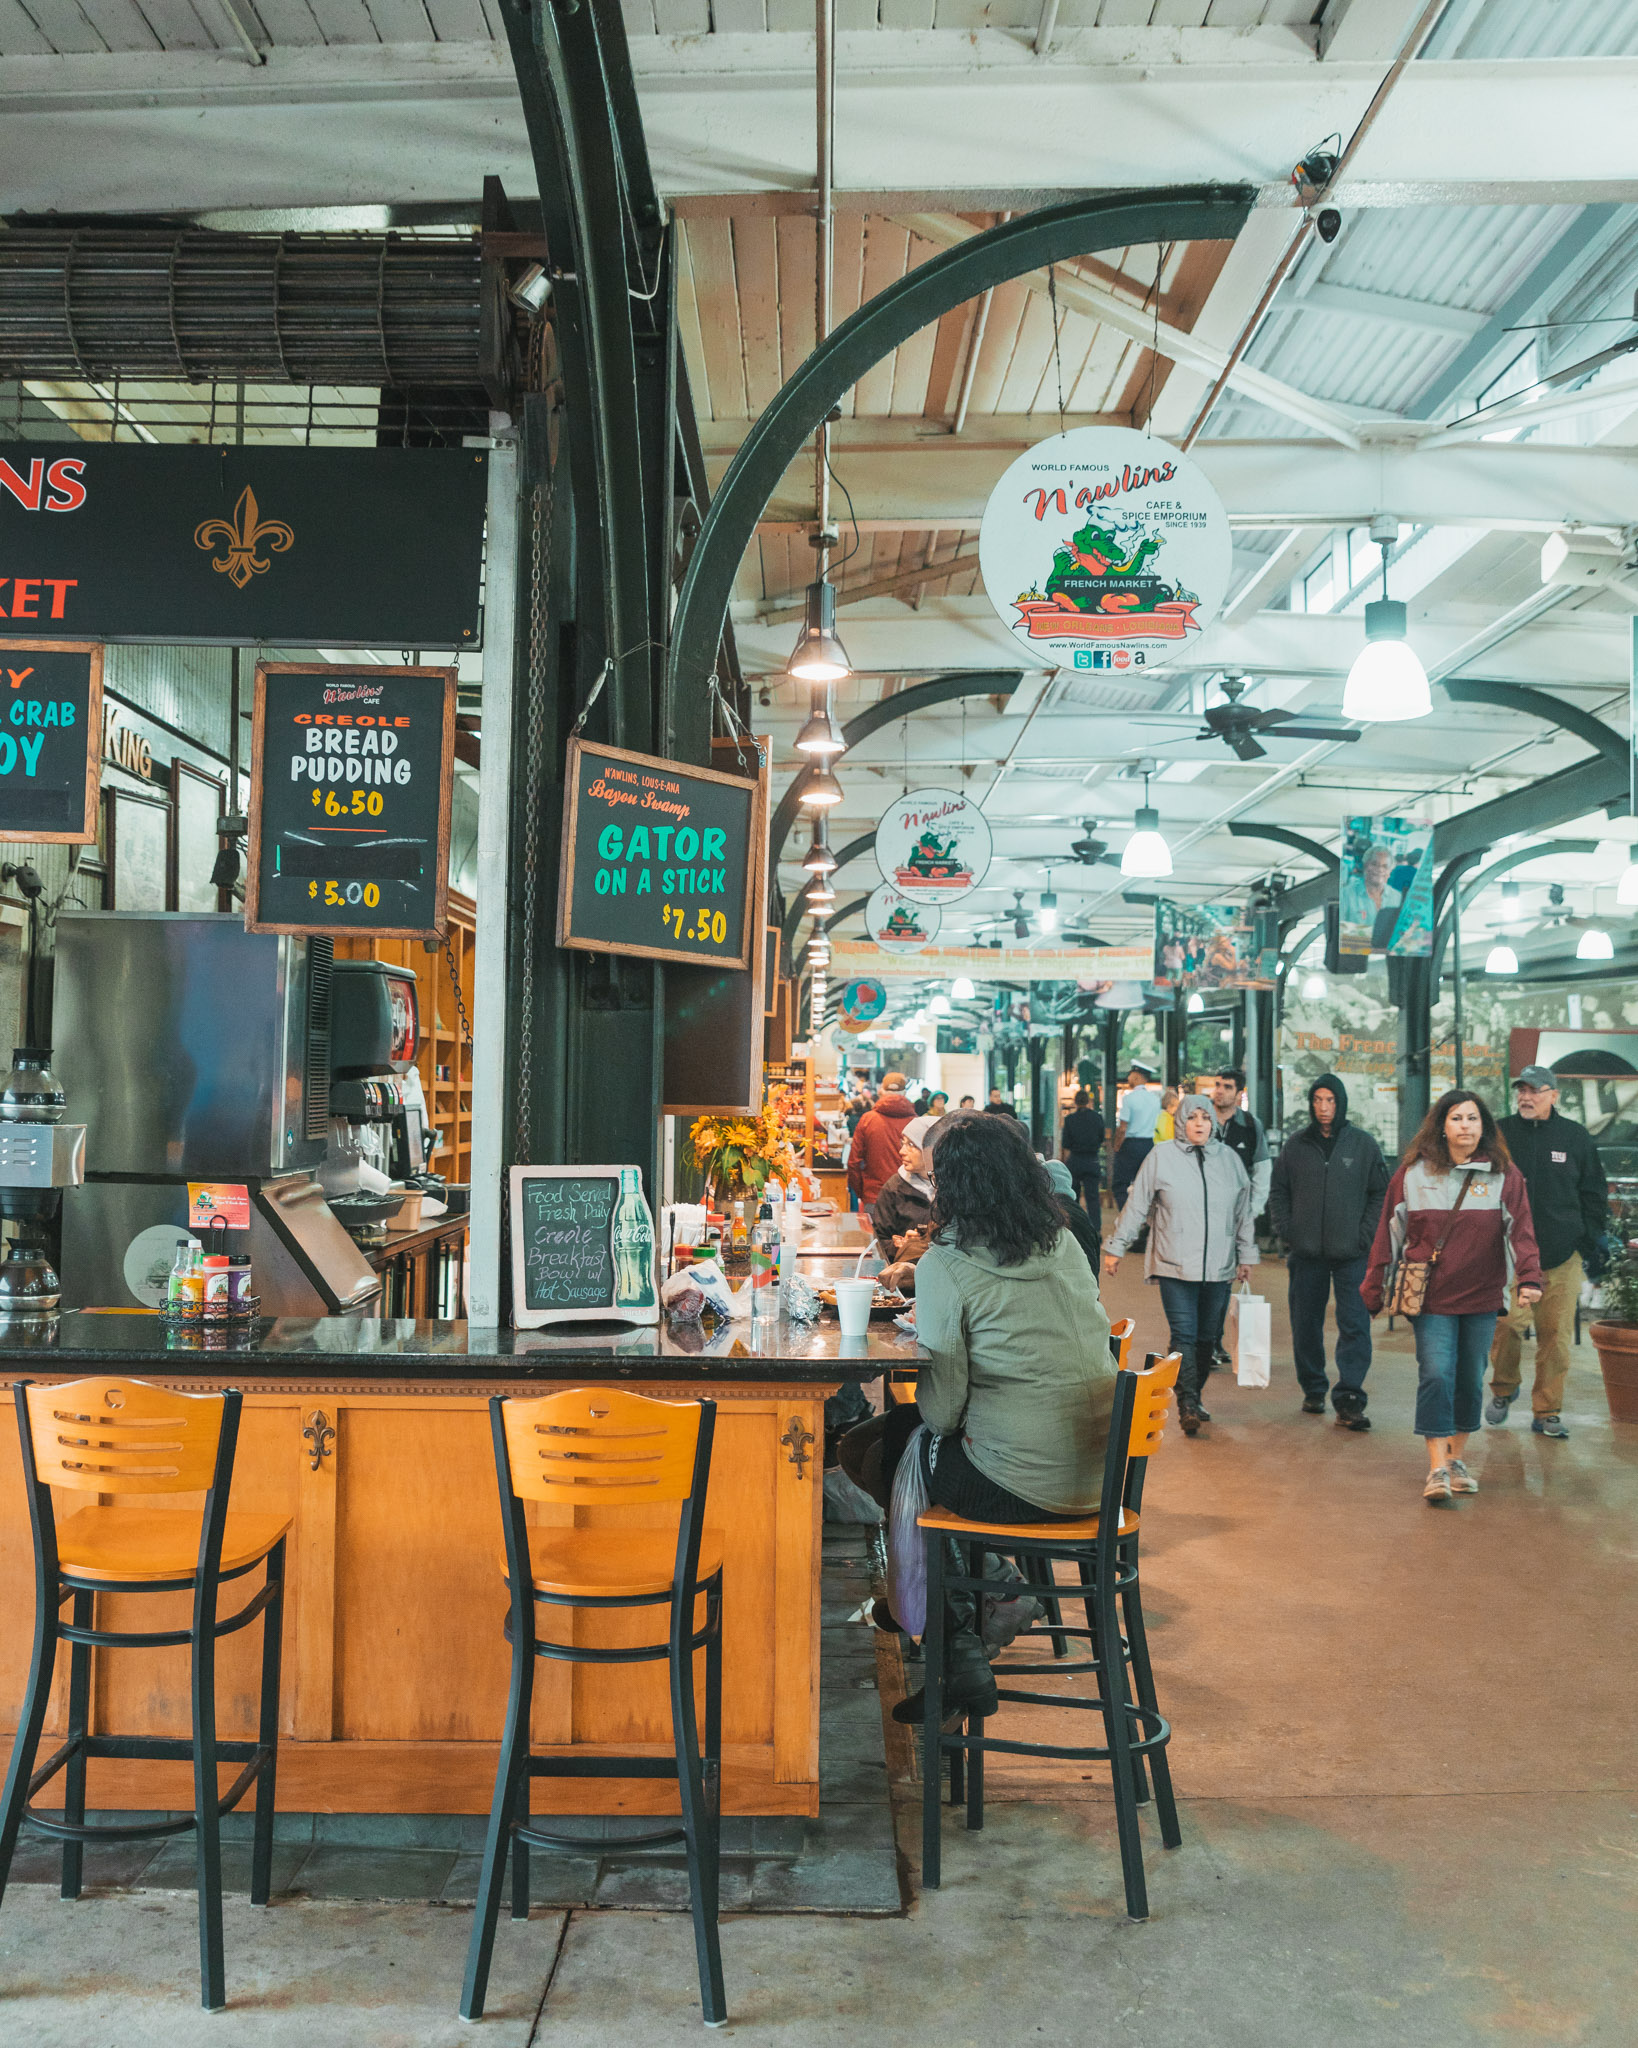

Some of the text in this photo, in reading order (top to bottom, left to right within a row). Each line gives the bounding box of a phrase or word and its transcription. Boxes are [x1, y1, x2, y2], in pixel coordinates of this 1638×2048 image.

[1031, 464, 1110, 472] WORLD FAMOUS
[1121, 511, 1207, 521] SPICE EMPORIUM
[1145, 501, 1182, 510] CAFE &
[1165, 521, 1207, 529] SINCE 1939
[1064, 579, 1154, 588] FRENCH MARKET
[1036, 620, 1180, 633] NEW ORLEANS LOUISIANA
[9, 699, 76, 728] CRAB
[293, 713, 411, 727] CREOLE
[305, 728, 399, 756] BREAD
[290, 754, 412, 785] PUDDING
[311, 788, 384, 817] $6.50
[587, 779, 690, 821] Bayou Swamp
[597, 824, 727, 863] GATOR
[594, 867, 727, 896] ON A STICK
[308, 879, 381, 909] $5.00
[662, 903, 727, 944] $7.50
[1296, 1032, 1333, 1051] The
[1338, 1034, 1397, 1055] Frenc
[528, 1183, 612, 1204] Food Served
[538, 1201, 611, 1229] Fresh Daily
[534, 1225, 593, 1245] Creole
[527, 1244, 607, 1269] Breakfast
[534, 1266, 581, 1281] Bowl
[534, 1279, 608, 1303] Hot Sausage
